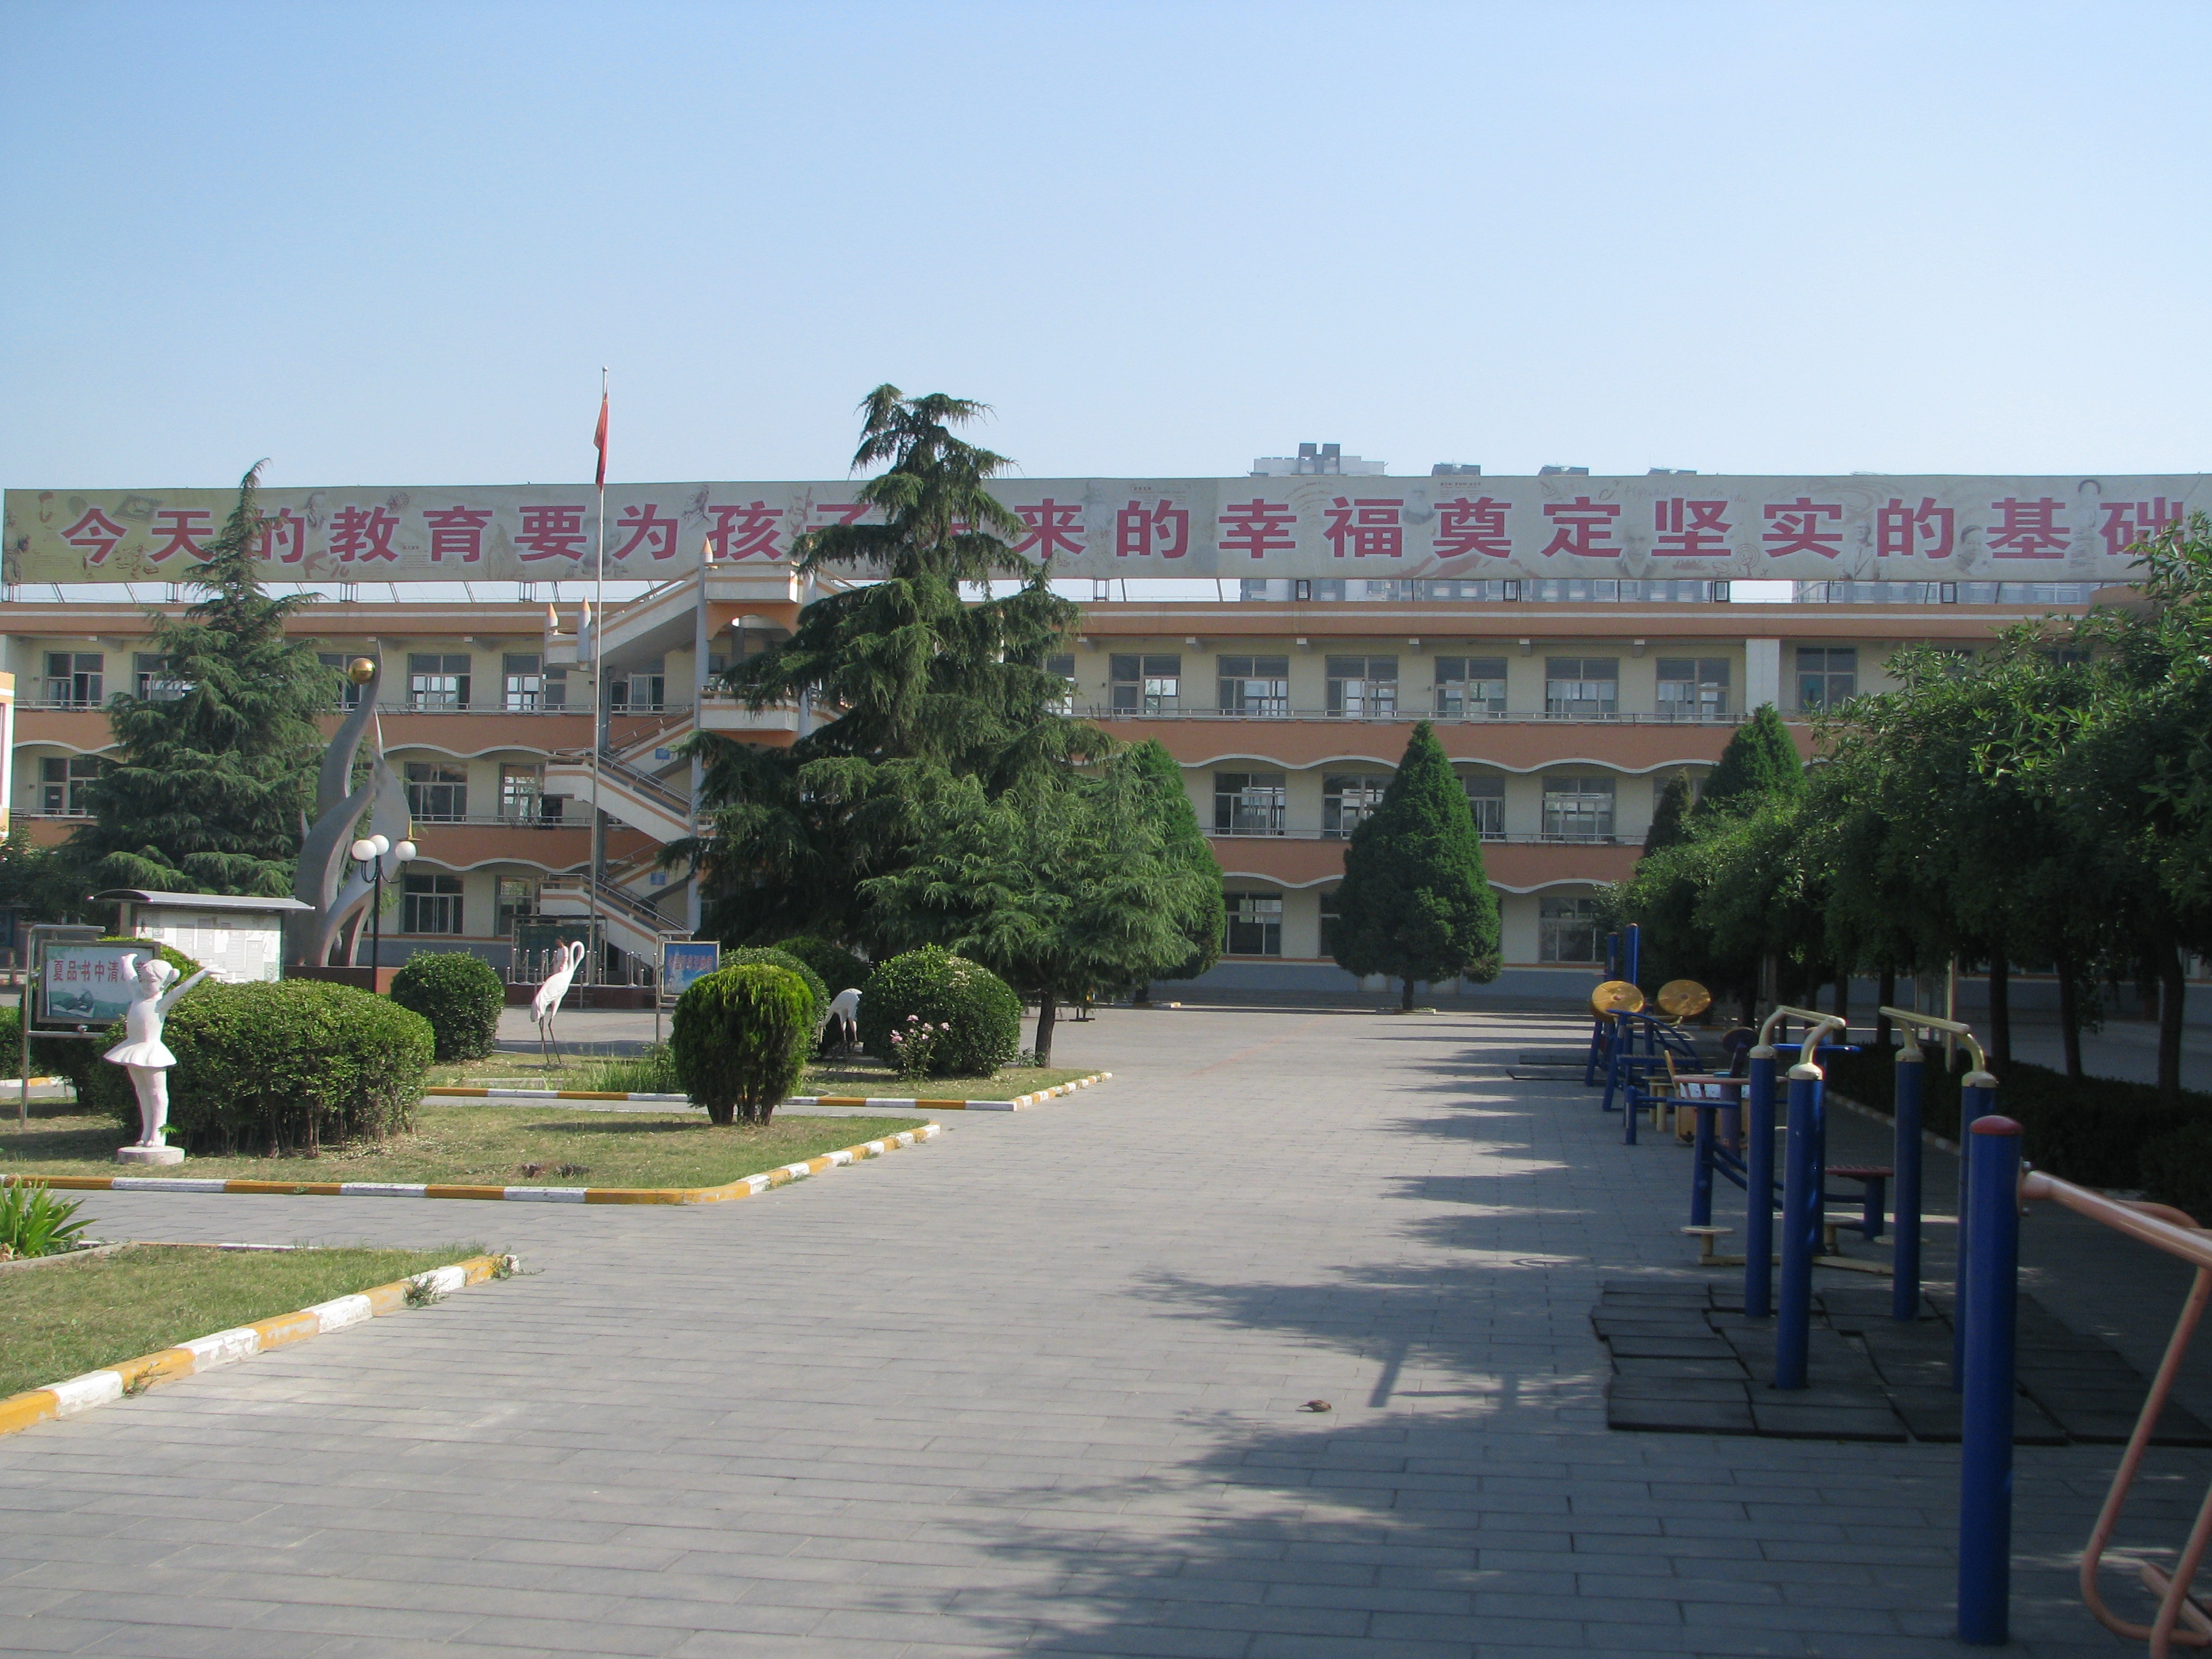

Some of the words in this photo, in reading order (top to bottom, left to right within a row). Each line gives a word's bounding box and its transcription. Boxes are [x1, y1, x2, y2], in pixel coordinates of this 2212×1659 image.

[60, 497, 2184, 563] 今天的教育要为孩来的幸福奠定坚实的基础
